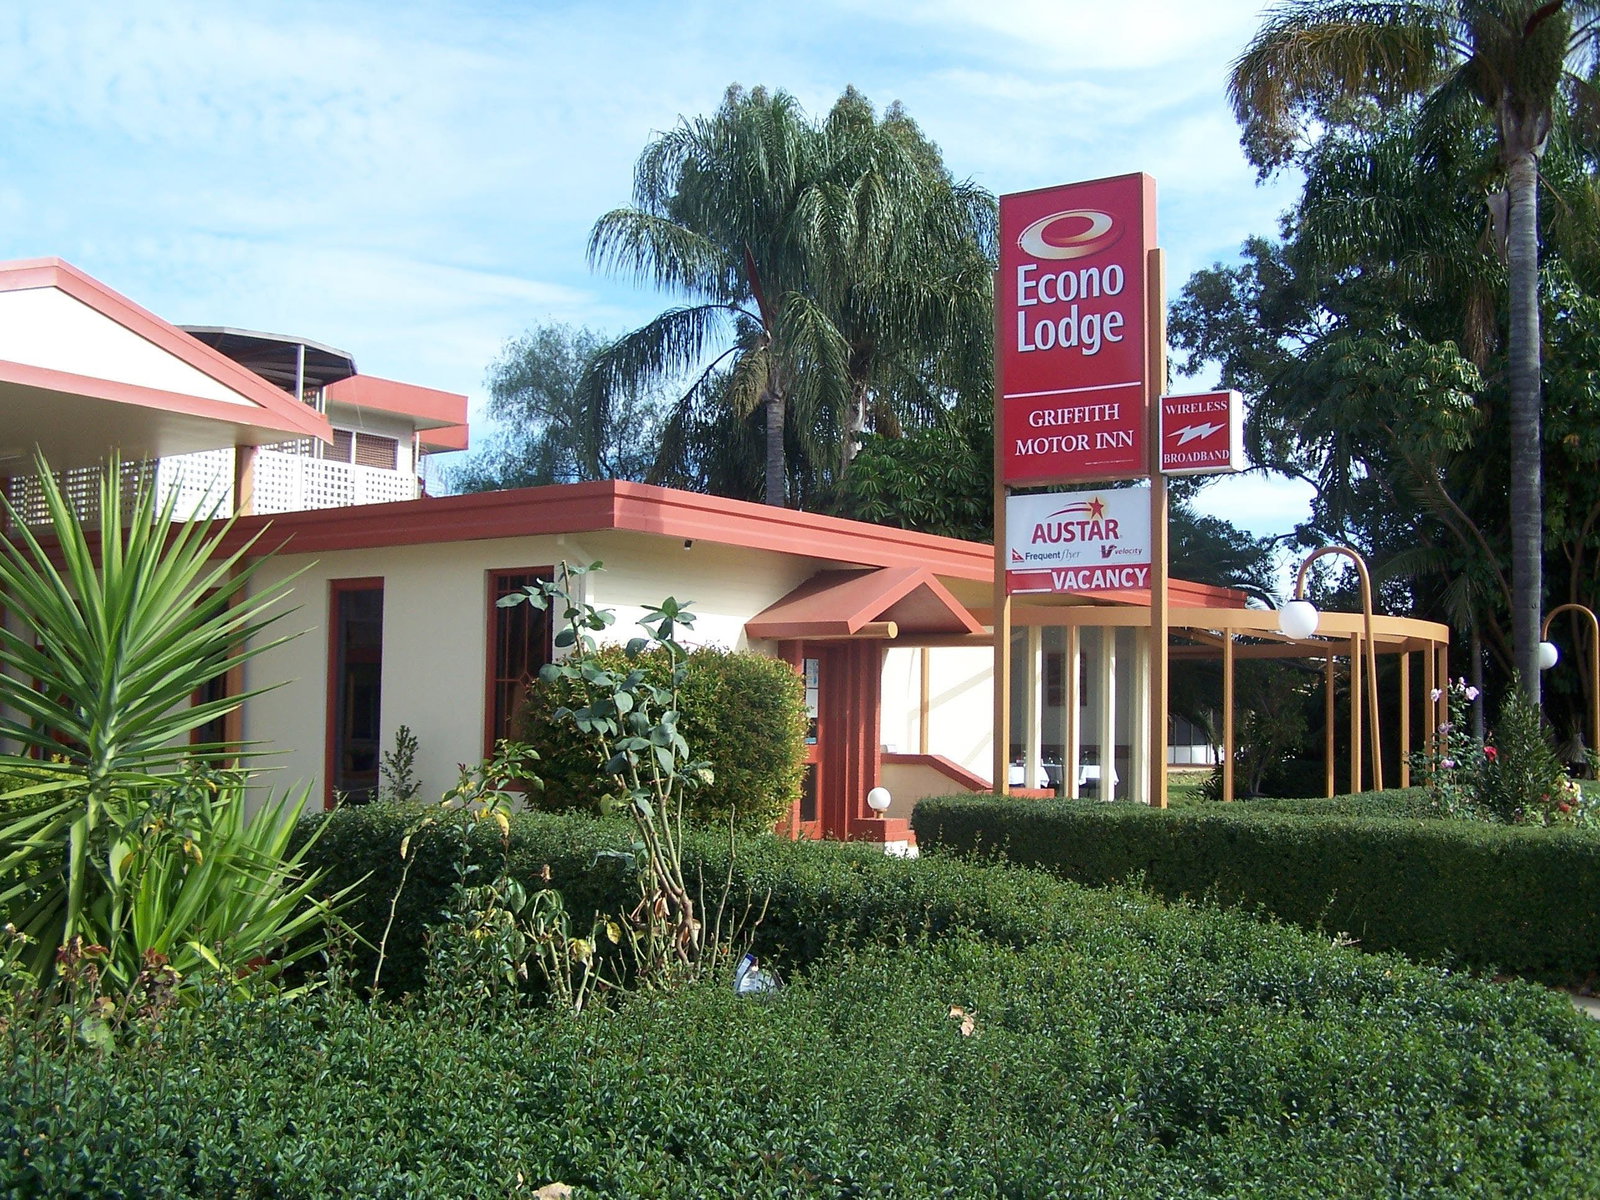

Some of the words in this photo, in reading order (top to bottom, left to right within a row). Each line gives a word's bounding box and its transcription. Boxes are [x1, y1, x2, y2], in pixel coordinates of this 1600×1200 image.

[1017, 264, 1125, 307] Econo
[1017, 304, 1125, 355] Lodge
[1028, 403, 1120, 427] GRIFFITH
[1165, 400, 1228, 415] WIRELESS
[1014, 434, 1089, 456] MOTOR
[1095, 430, 1135, 449] INN
[1163, 449, 1229, 464] BROADBAND
[1032, 519, 1119, 544] AUSTAR
[1025, 551, 1061, 561] Frequent
[1061, 549, 1081, 562] flyer
[1115, 547, 1143, 555] velocity
[1052, 567, 1148, 589] VACANCY
